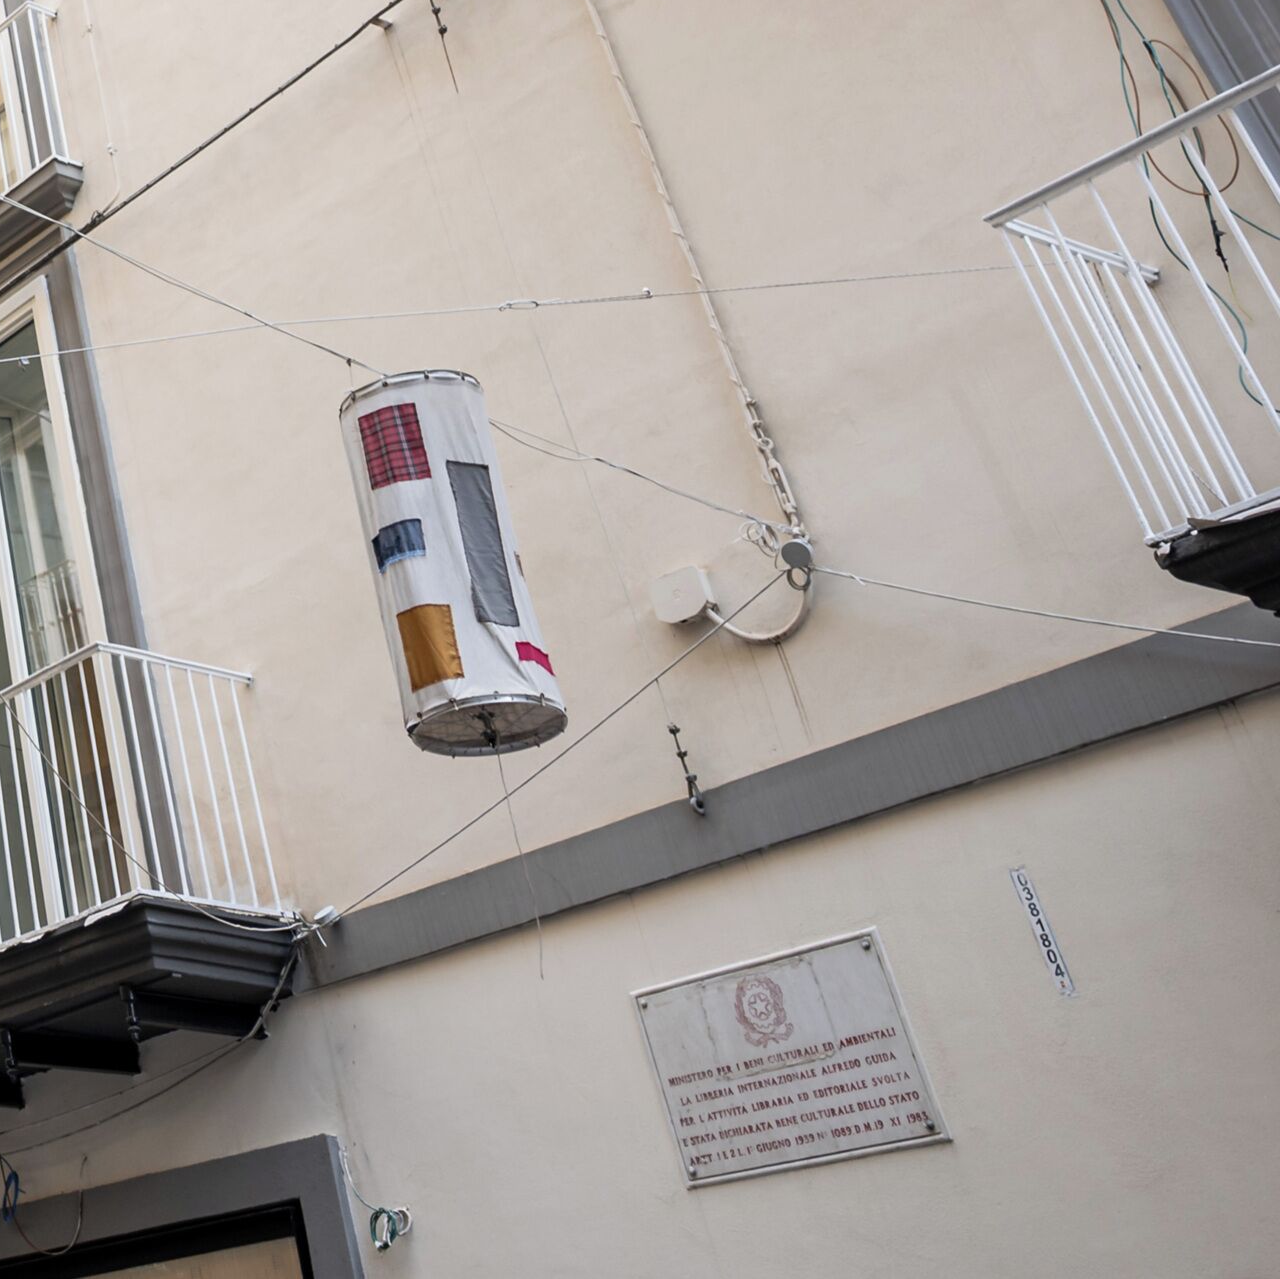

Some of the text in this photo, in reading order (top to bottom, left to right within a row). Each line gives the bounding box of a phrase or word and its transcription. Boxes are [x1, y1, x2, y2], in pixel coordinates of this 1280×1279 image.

[668, 1070, 713, 1086] MINISTERO
[717, 1066, 732, 1075] PER
[744, 1058, 763, 1070] BENI
[768, 1045, 818, 1063] CULTURALI
[839, 1028, 896, 1049] AMBIENTALI
[696, 1088, 734, 1102] LIBRERIA
[738, 1069, 816, 1093] INTERNAZIONALE
[822, 1059, 860, 1075] ALFREDO
[865, 1052, 896, 1065] GUIDA
[752, 1096, 794, 1112] LIBRARIA
[813, 1080, 868, 1098] EDITORIALE
[872, 1072, 910, 1086] SVOLTA
[690, 1134, 716, 1146] STATA
[719, 1122, 773, 1139] DICHIARATA
[776, 1116, 798, 1127] BENE
[800, 1104, 855, 1122] CULTURALE
[857, 1098, 886, 1111] DELLO
[889, 1091, 919, 1105] STATO
[756, 1138, 791, 1152] GIUGNO
[795, 1134, 814, 1144] 1939
